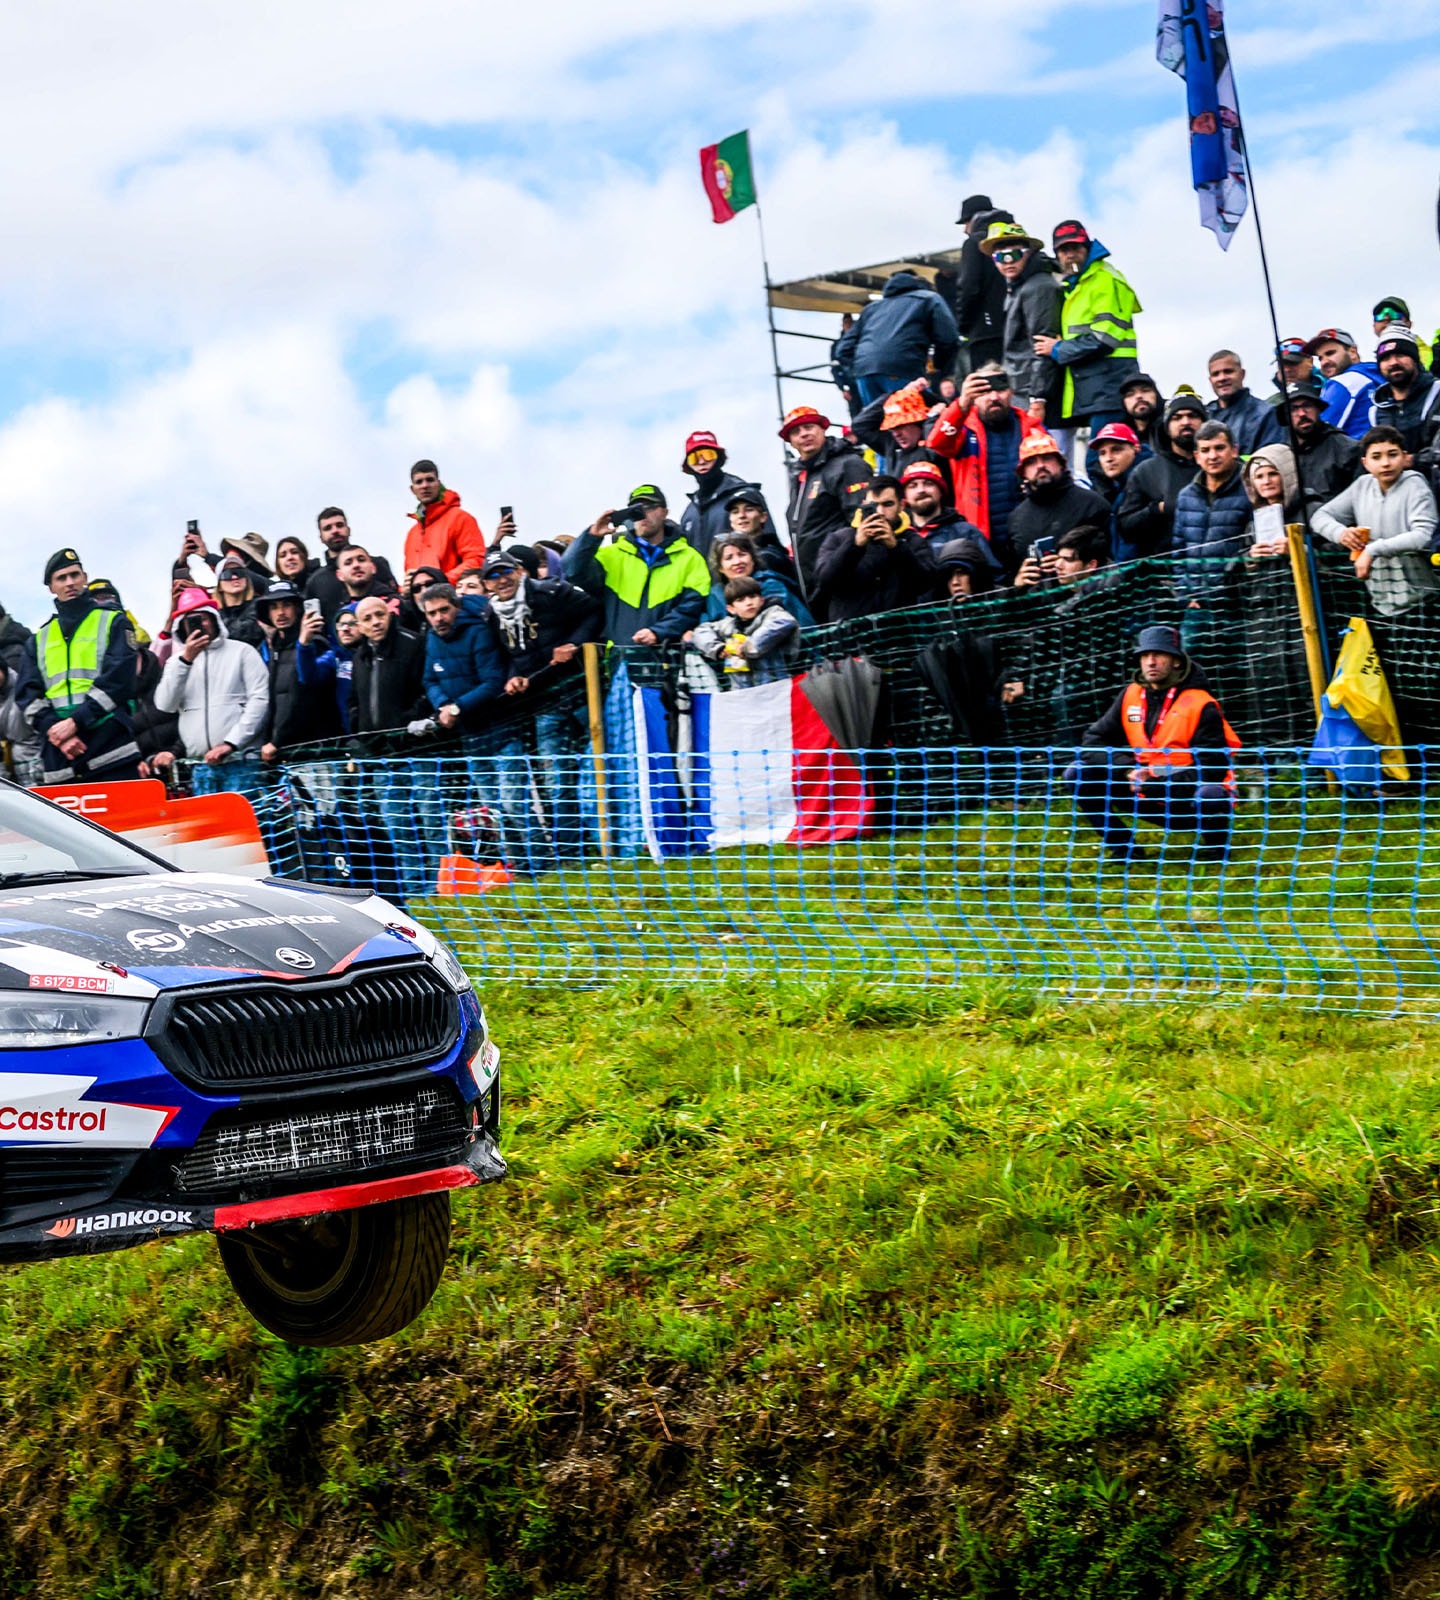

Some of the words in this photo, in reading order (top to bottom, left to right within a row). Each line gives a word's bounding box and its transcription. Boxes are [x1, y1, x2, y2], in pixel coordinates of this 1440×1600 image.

[52, 793, 108, 814] RC
[31, 975, 40, 986] S
[44, 976, 75, 988] 6179
[77, 978, 106, 990] BCM
